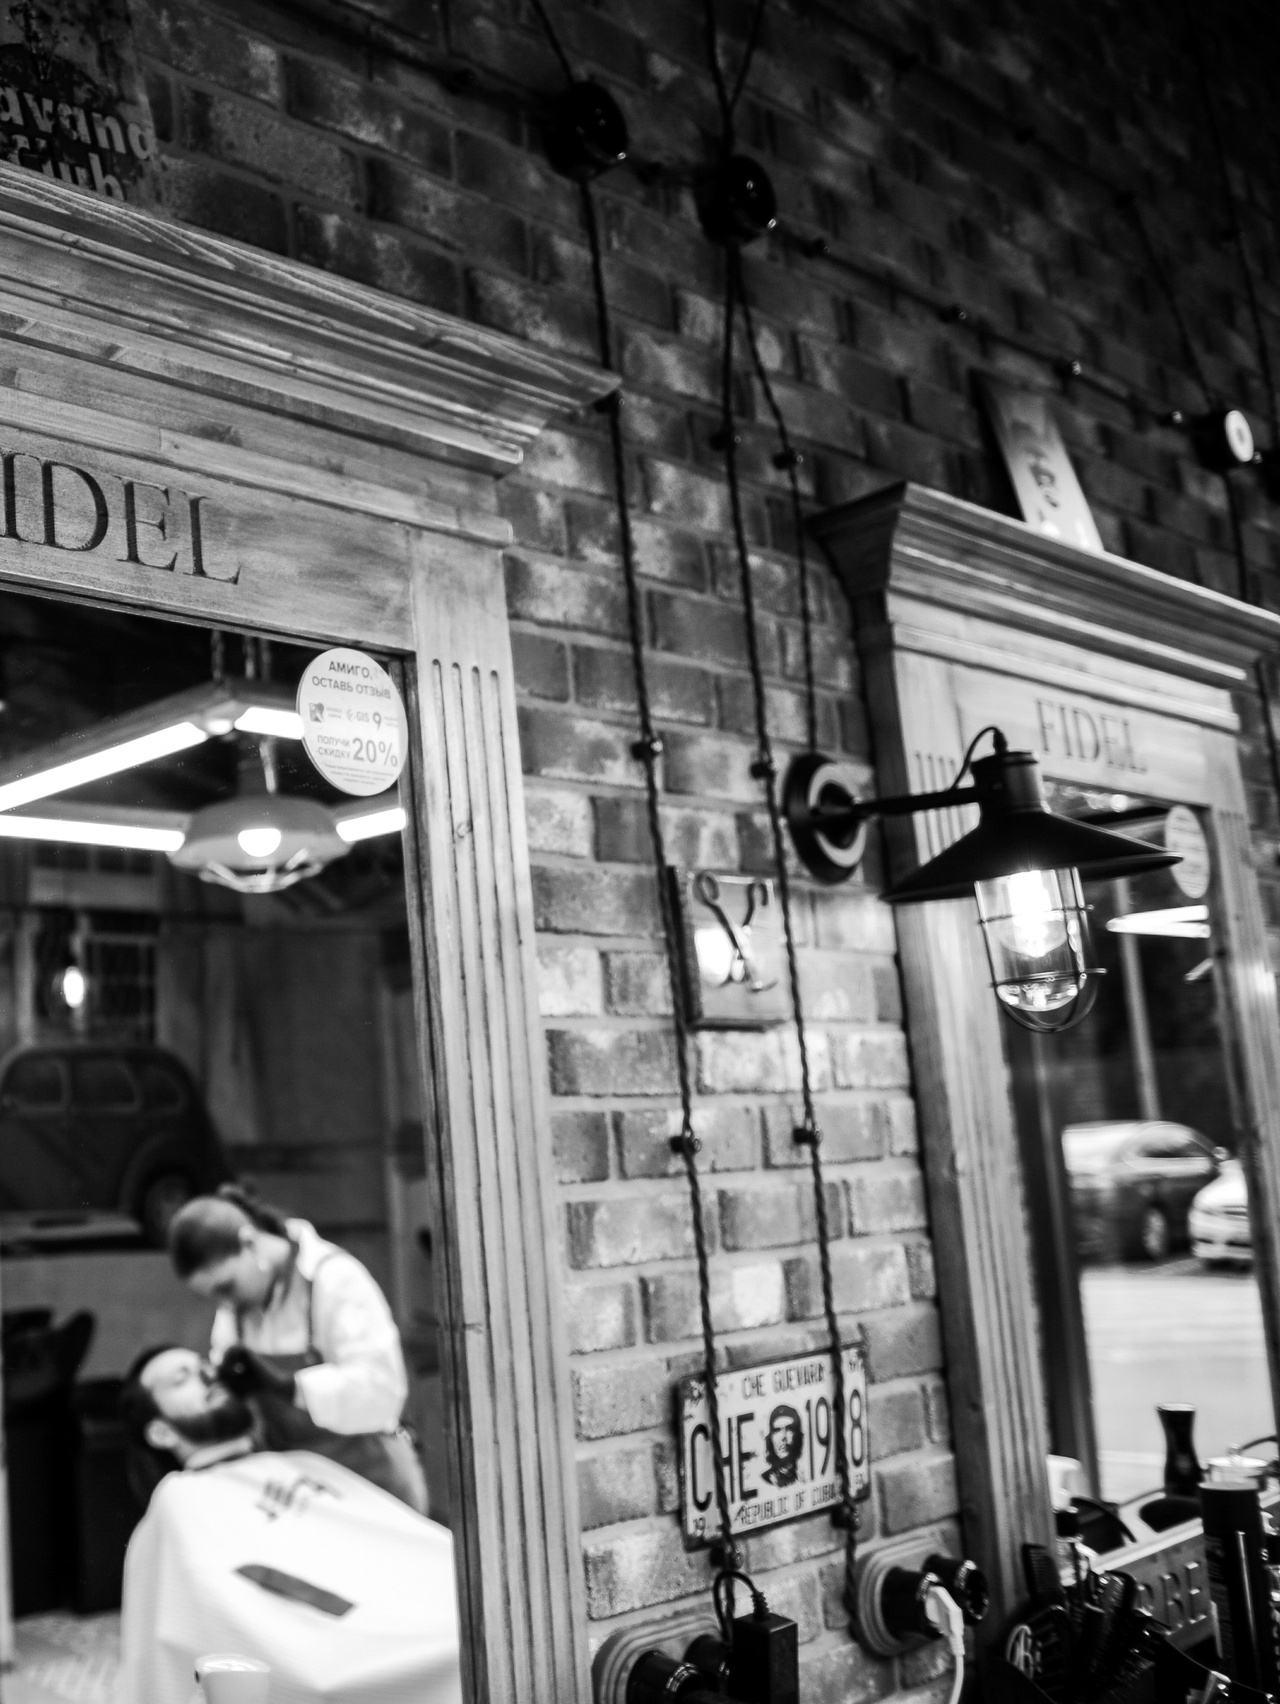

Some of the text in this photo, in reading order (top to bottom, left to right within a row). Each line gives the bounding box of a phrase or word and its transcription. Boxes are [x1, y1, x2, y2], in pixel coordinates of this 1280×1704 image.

[311, 675, 391, 700] ОСТАВЬ ОТЗЫВ
[352, 737, 398, 767] 20%
[1035, 698, 1148, 774] FIDEL
[691, 1412, 758, 1513] CHE
